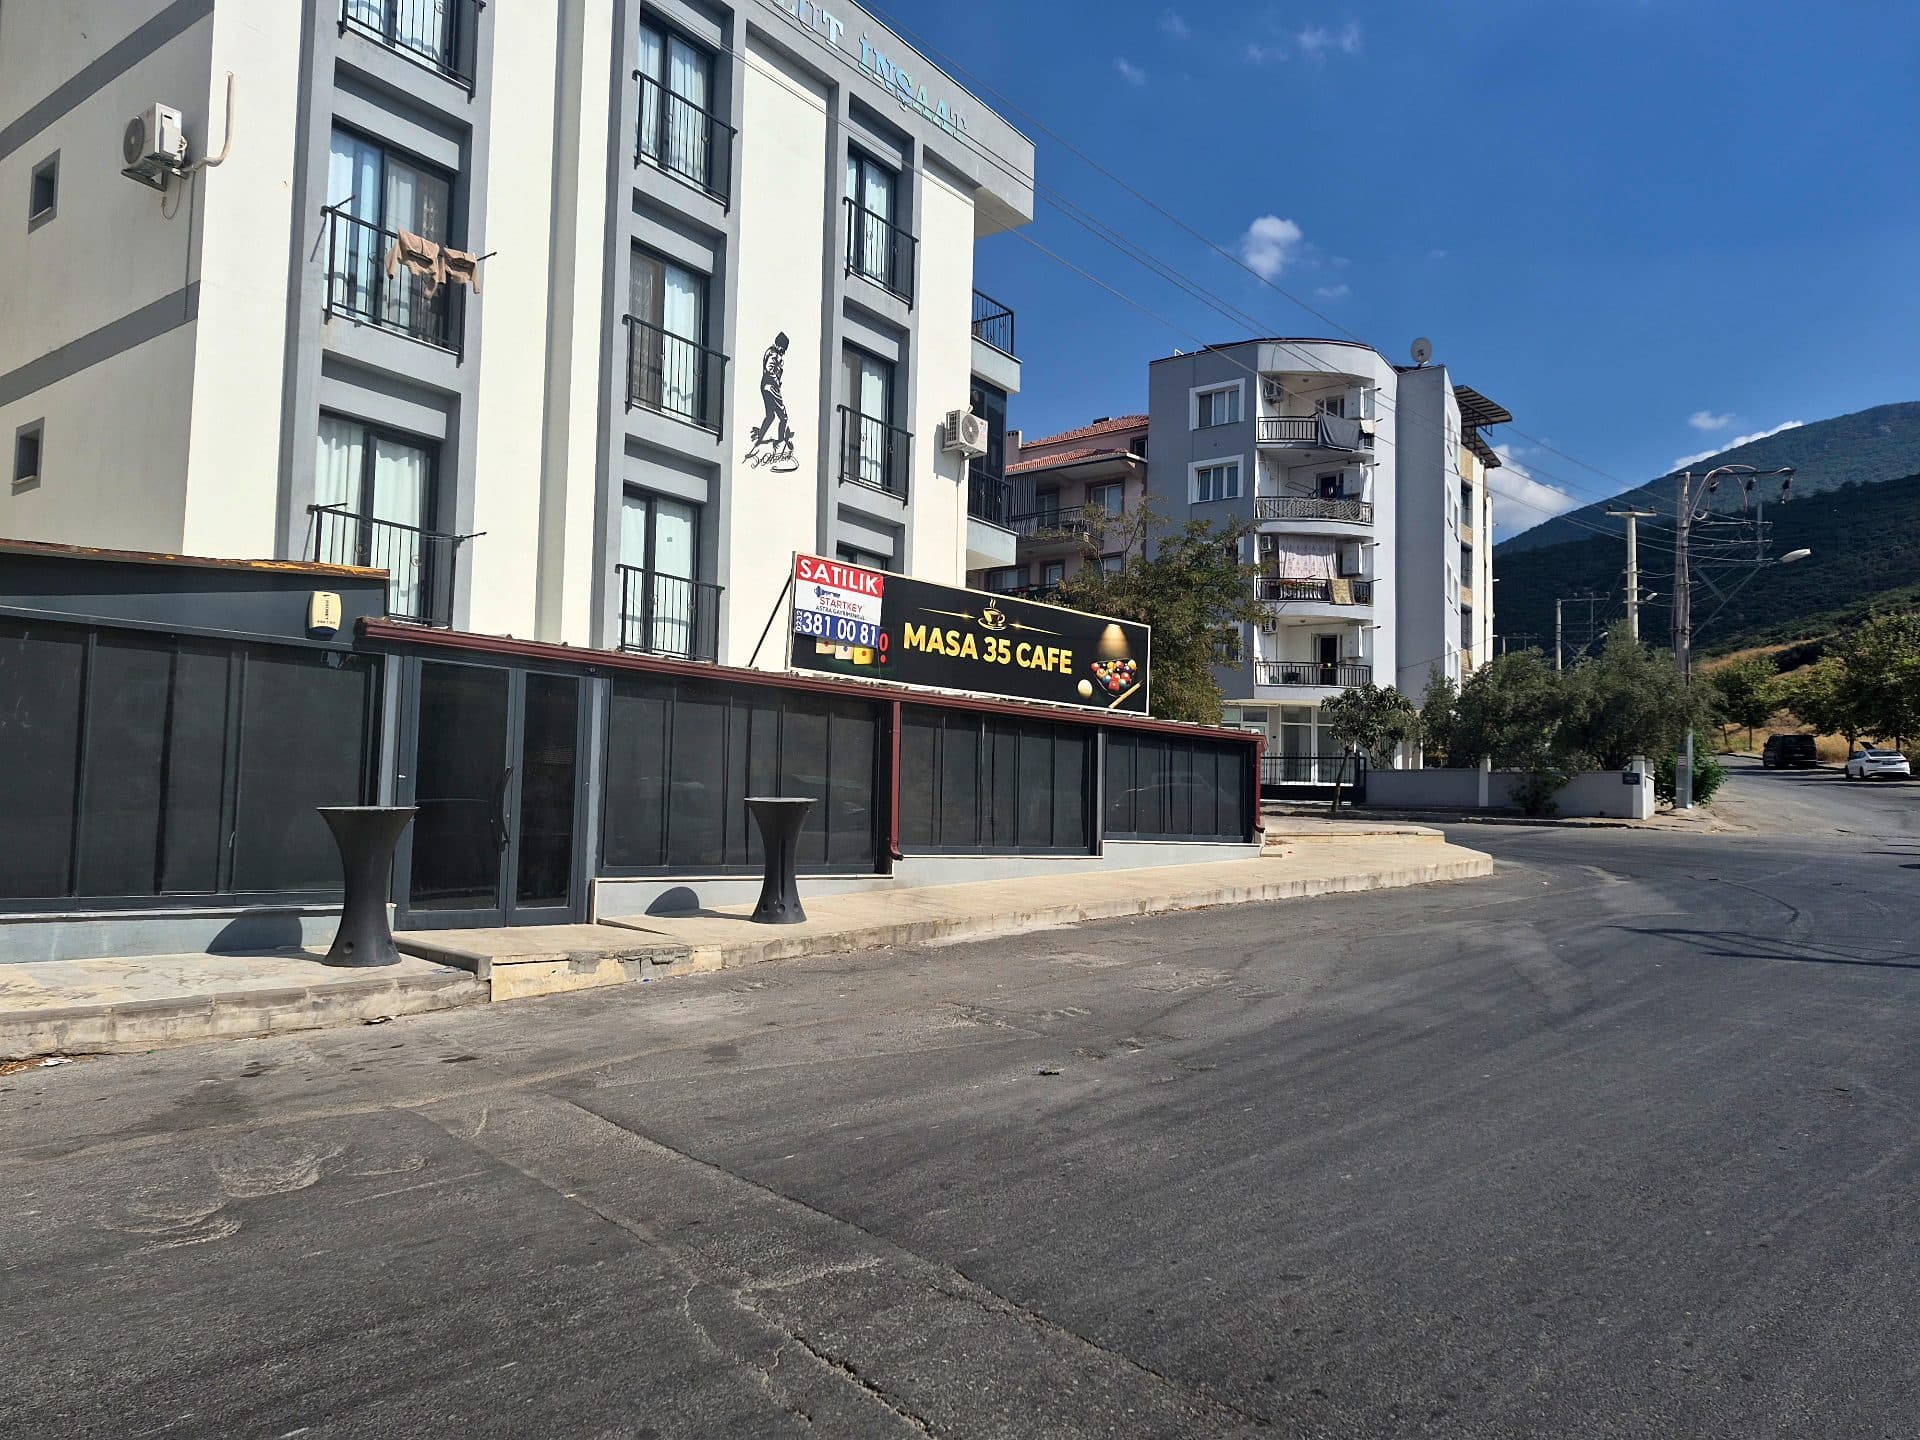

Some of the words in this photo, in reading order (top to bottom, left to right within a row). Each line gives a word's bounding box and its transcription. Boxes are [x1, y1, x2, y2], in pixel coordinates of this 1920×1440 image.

[858, 31, 968, 143] İNŞAAT
[799, 558, 878, 594] SATILIK
[819, 597, 863, 614] STARTKEY
[802, 611, 831, 637] 381
[837, 618, 856, 642] 00
[860, 623, 877, 646] 81
[903, 622, 979, 660] MASA
[983, 636, 1012, 665] 35
[1016, 642, 1073, 675] CAFE
